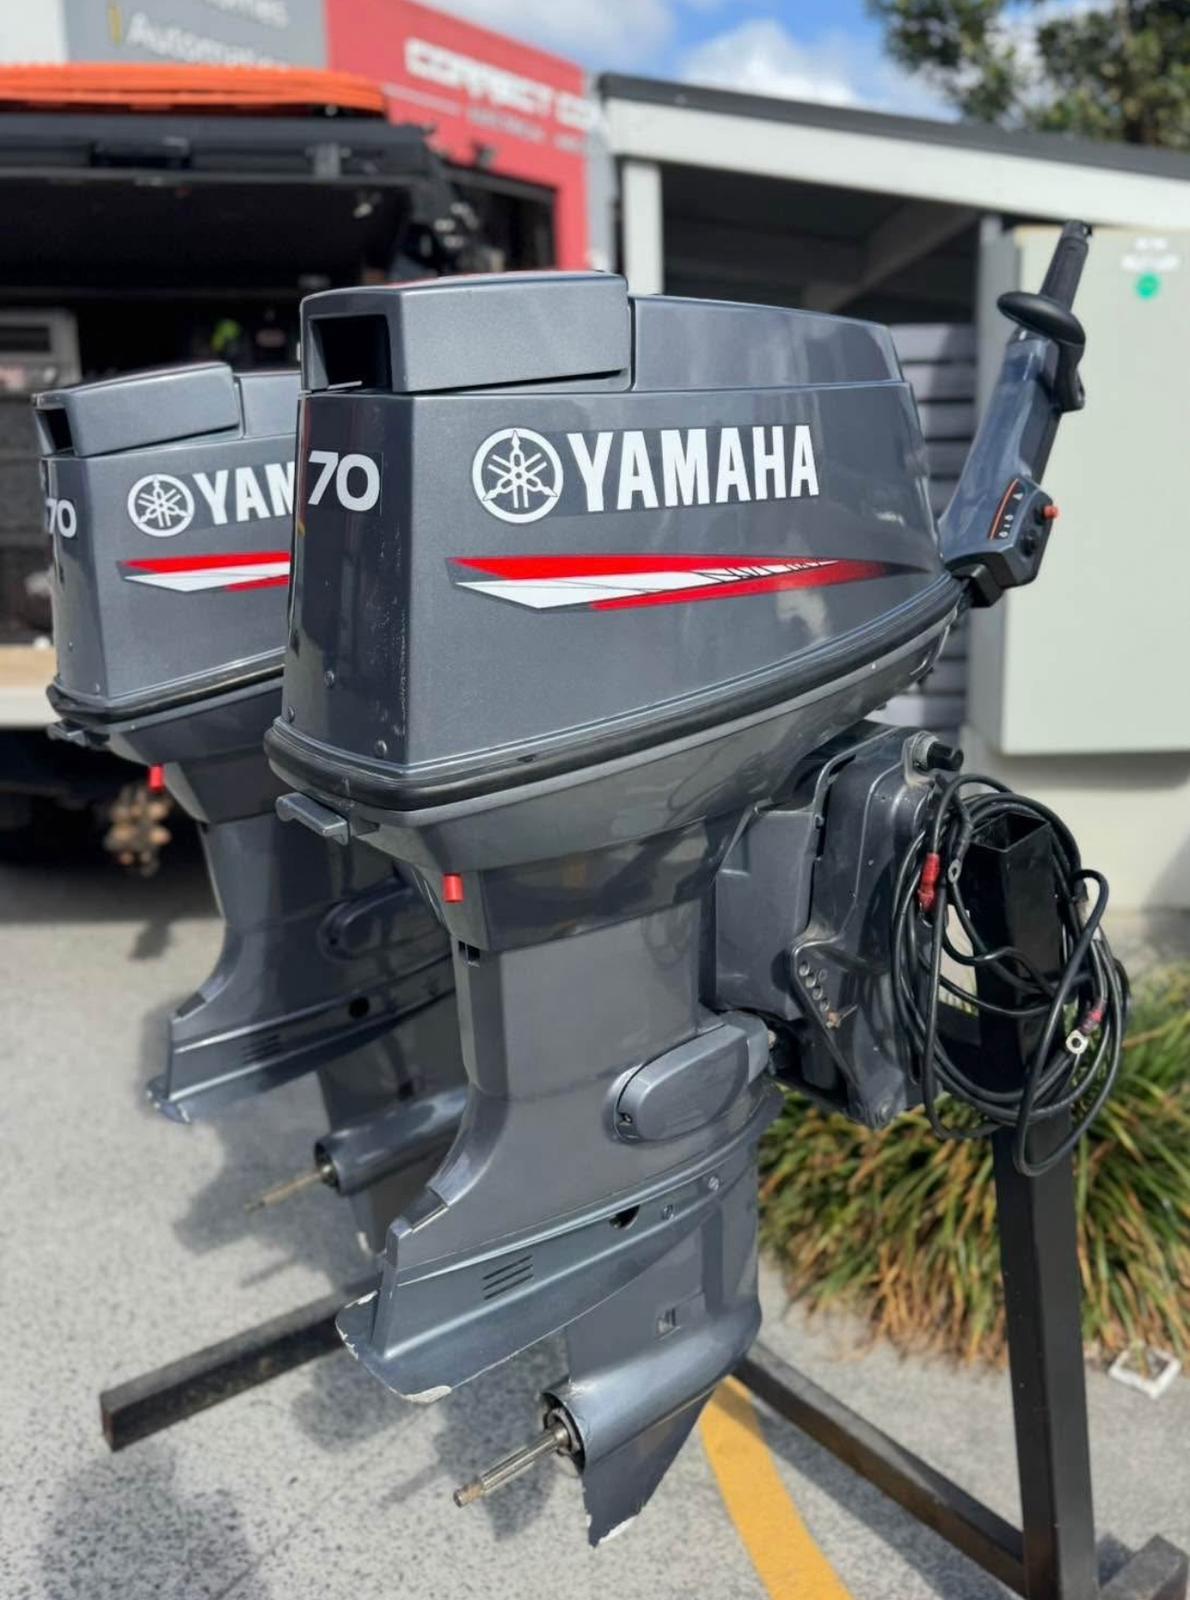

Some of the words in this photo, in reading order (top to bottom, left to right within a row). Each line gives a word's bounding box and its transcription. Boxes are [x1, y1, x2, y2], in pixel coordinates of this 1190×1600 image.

[308, 451, 381, 512] 70
[567, 424, 819, 512] YAMAHA
[47, 498, 77, 539] 70
